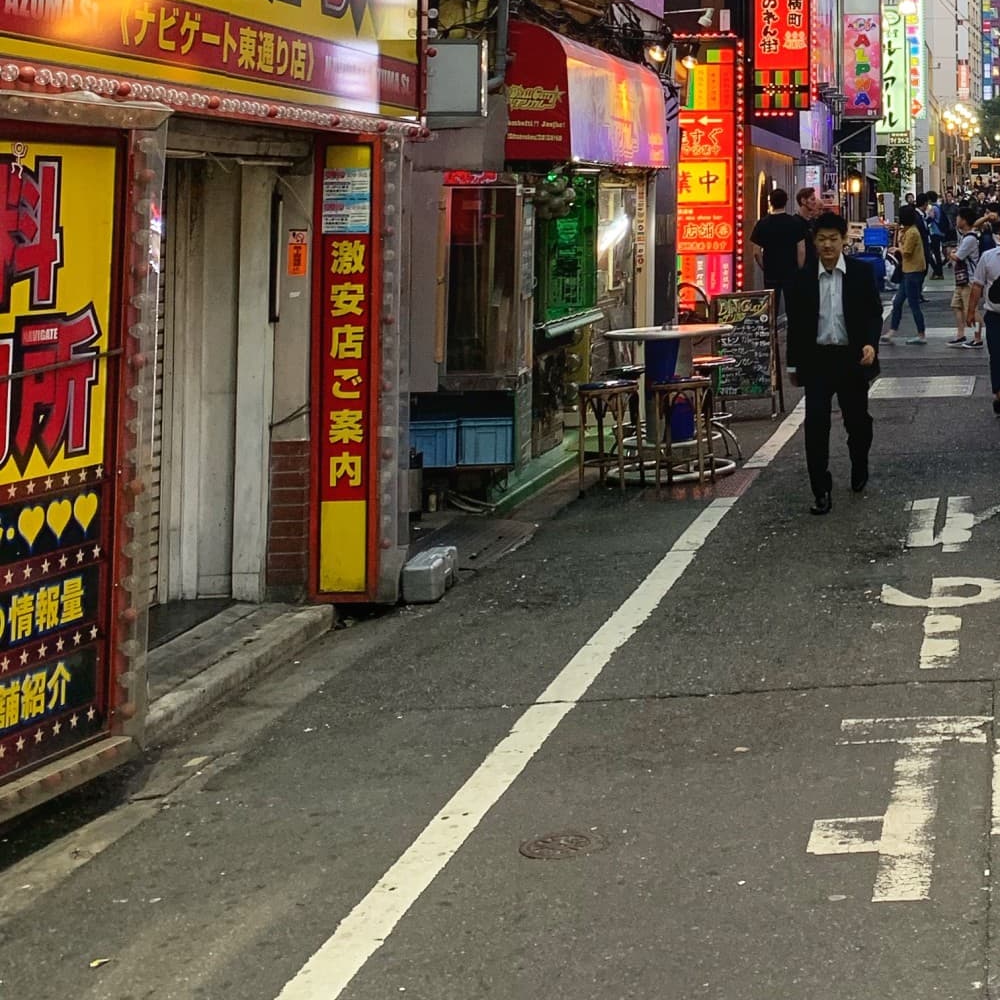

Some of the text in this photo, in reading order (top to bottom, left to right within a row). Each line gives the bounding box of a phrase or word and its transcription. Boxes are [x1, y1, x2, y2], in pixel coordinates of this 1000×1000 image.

[328, 240, 366, 488] 激安店ご案内
